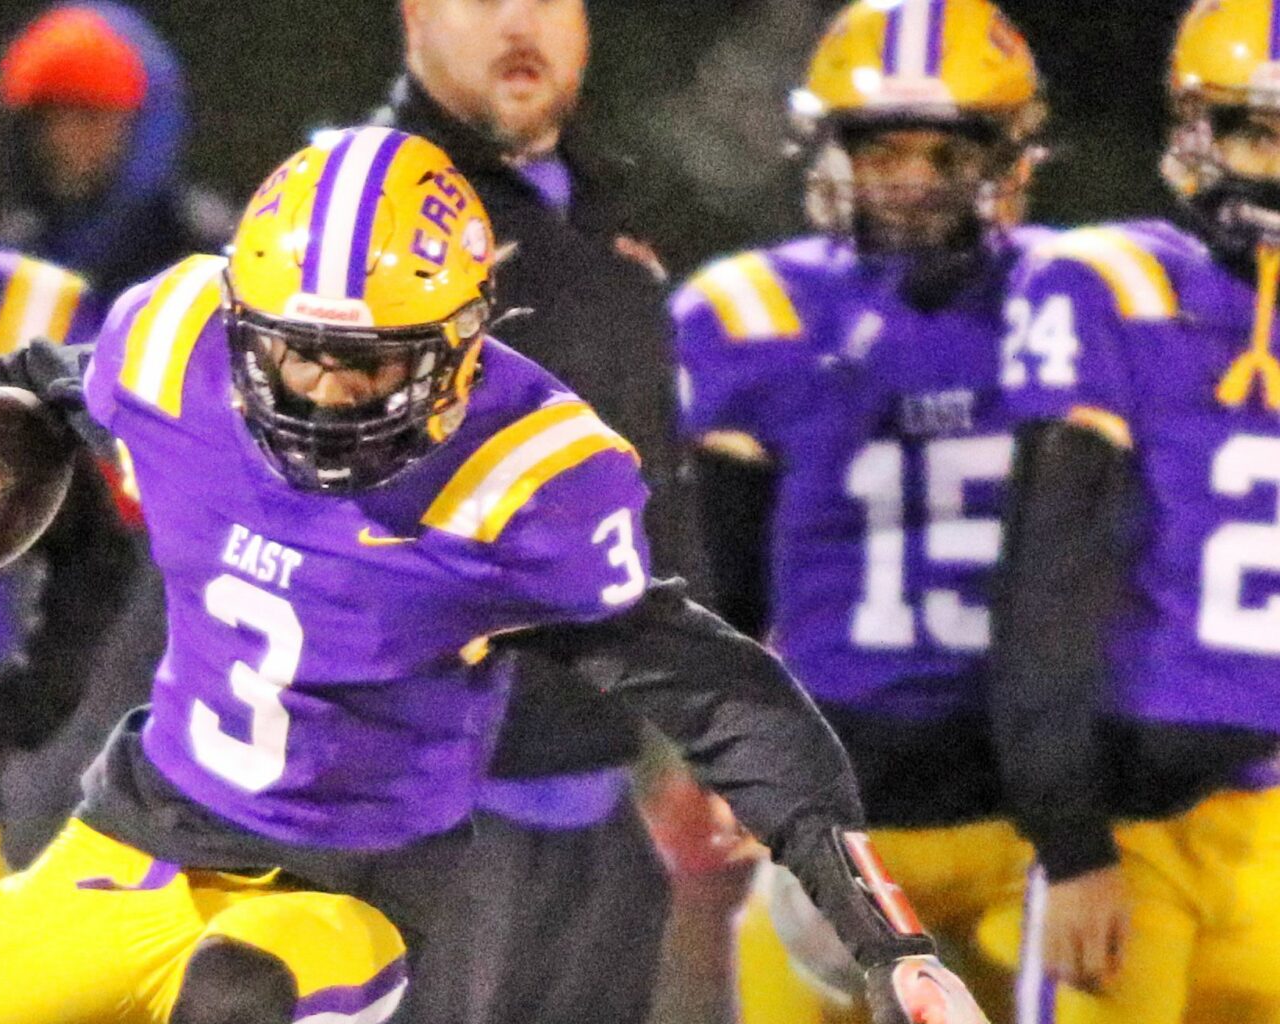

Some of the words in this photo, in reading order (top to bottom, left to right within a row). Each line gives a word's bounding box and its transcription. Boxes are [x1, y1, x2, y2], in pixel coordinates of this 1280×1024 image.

[410, 166, 468, 266] EAS
[223, 522, 302, 589] EAST
[591, 507, 644, 606] 3
[846, 436, 1013, 649] 15
[189, 573, 302, 791] 3
